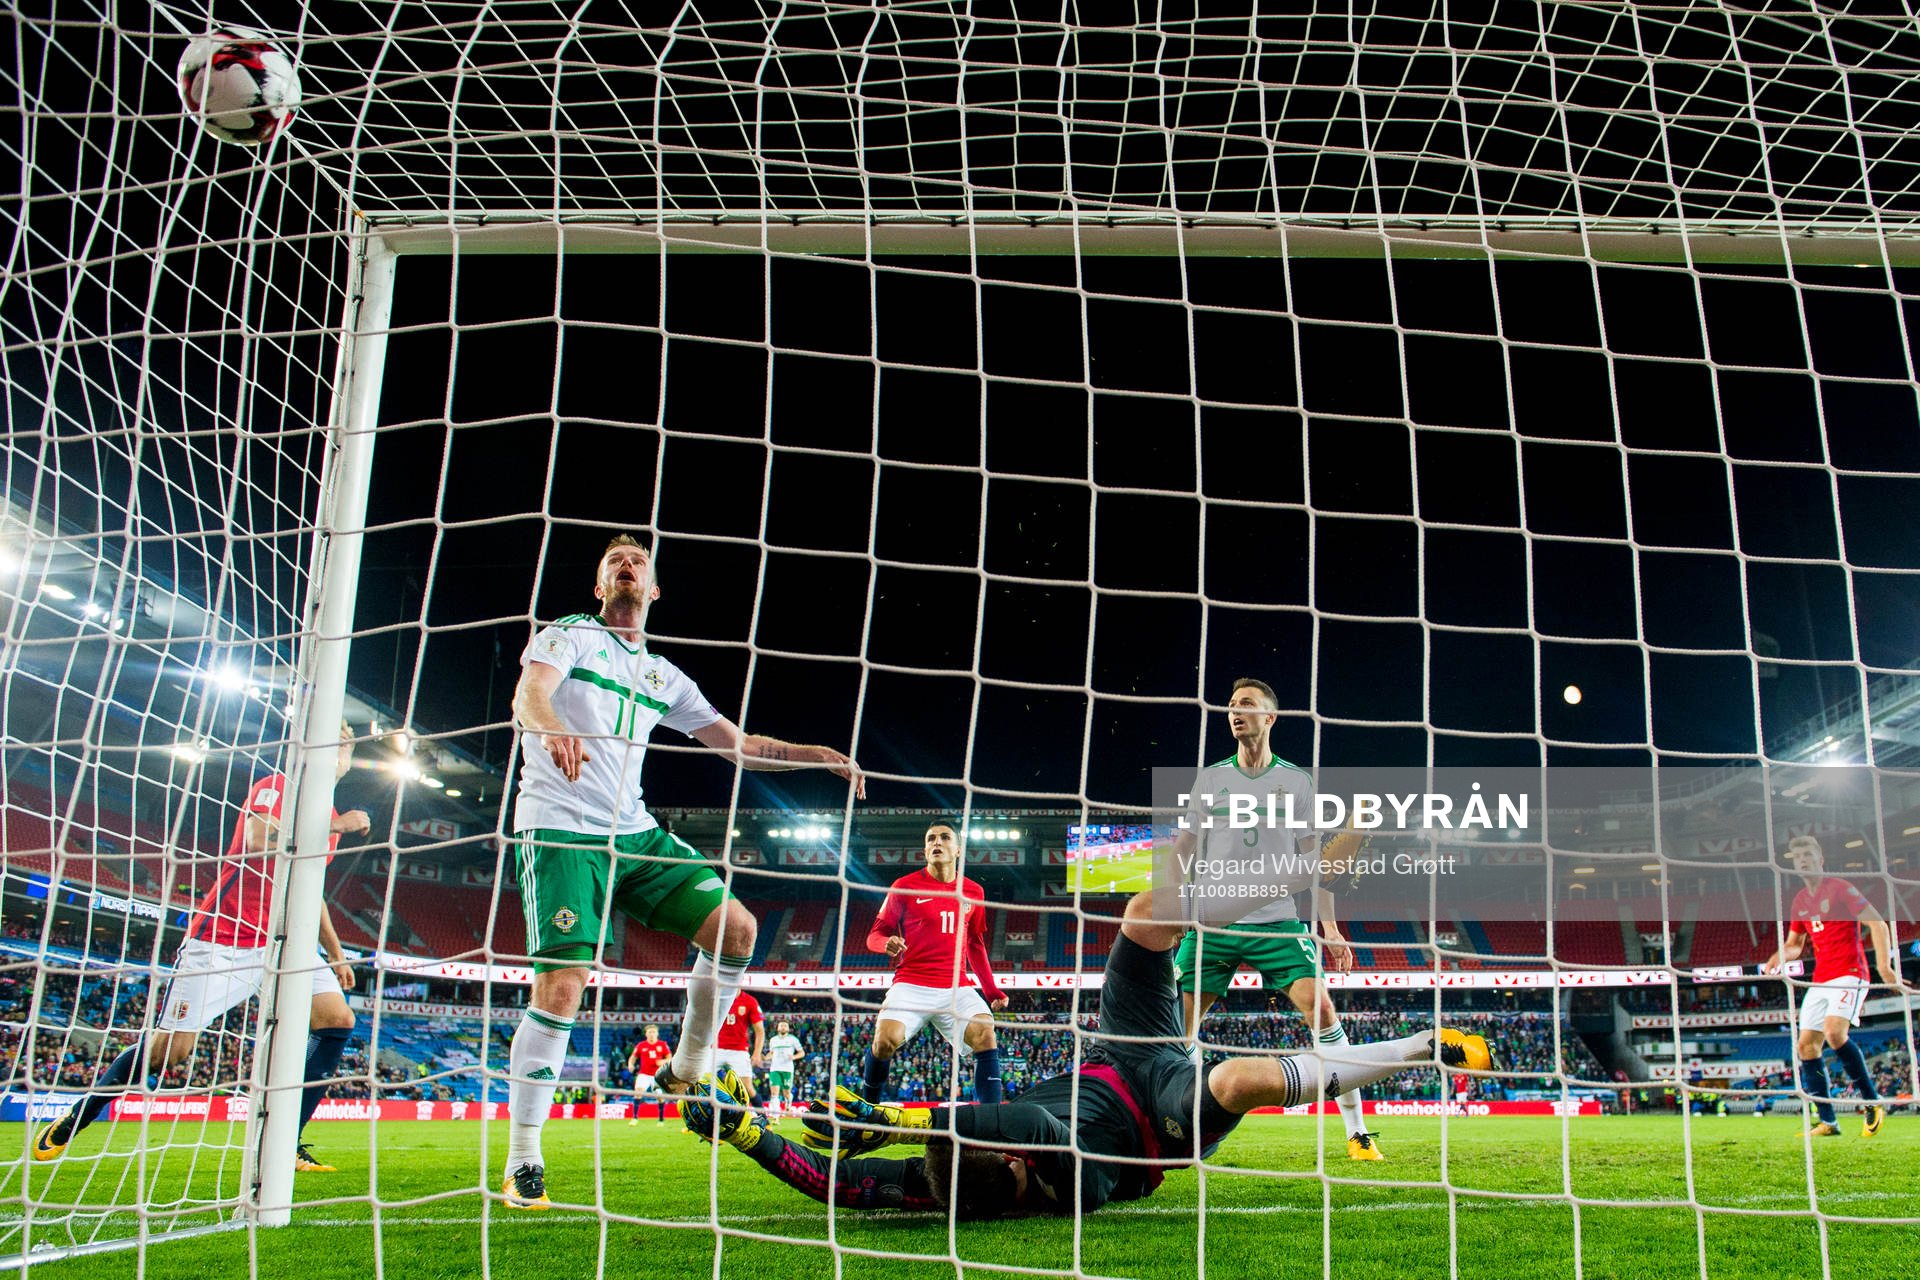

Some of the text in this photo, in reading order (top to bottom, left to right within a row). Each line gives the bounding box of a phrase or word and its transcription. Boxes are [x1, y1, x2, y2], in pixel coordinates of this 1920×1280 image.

[614, 696, 637, 741] 11
[966, 849, 1019, 865] VG
[940, 911, 955, 934] 11
[1005, 933, 1033, 941] VG
[1297, 936, 1317, 963] 5
[772, 975, 818, 987] VG
[838, 975, 884, 987] VG
[1036, 975, 1082, 987] VG
[1364, 975, 1410, 986] VG
[1429, 975, 1475, 986] VG
[1494, 974, 1540, 985] VG
[1559, 973, 1605, 985] VG
[1626, 972, 1672, 984] VG
[603, 1012, 636, 1022] VG
[641, 1012, 674, 1022] VG
[726, 1013, 736, 1026] 19
[1634, 1017, 1670, 1027] VG
[1710, 1015, 1745, 1025] VG
[1749, 1013, 1781, 1024] VG
[1703, 1066, 1740, 1077] VG
[1374, 1101, 1490, 1116] thonhotelsno
